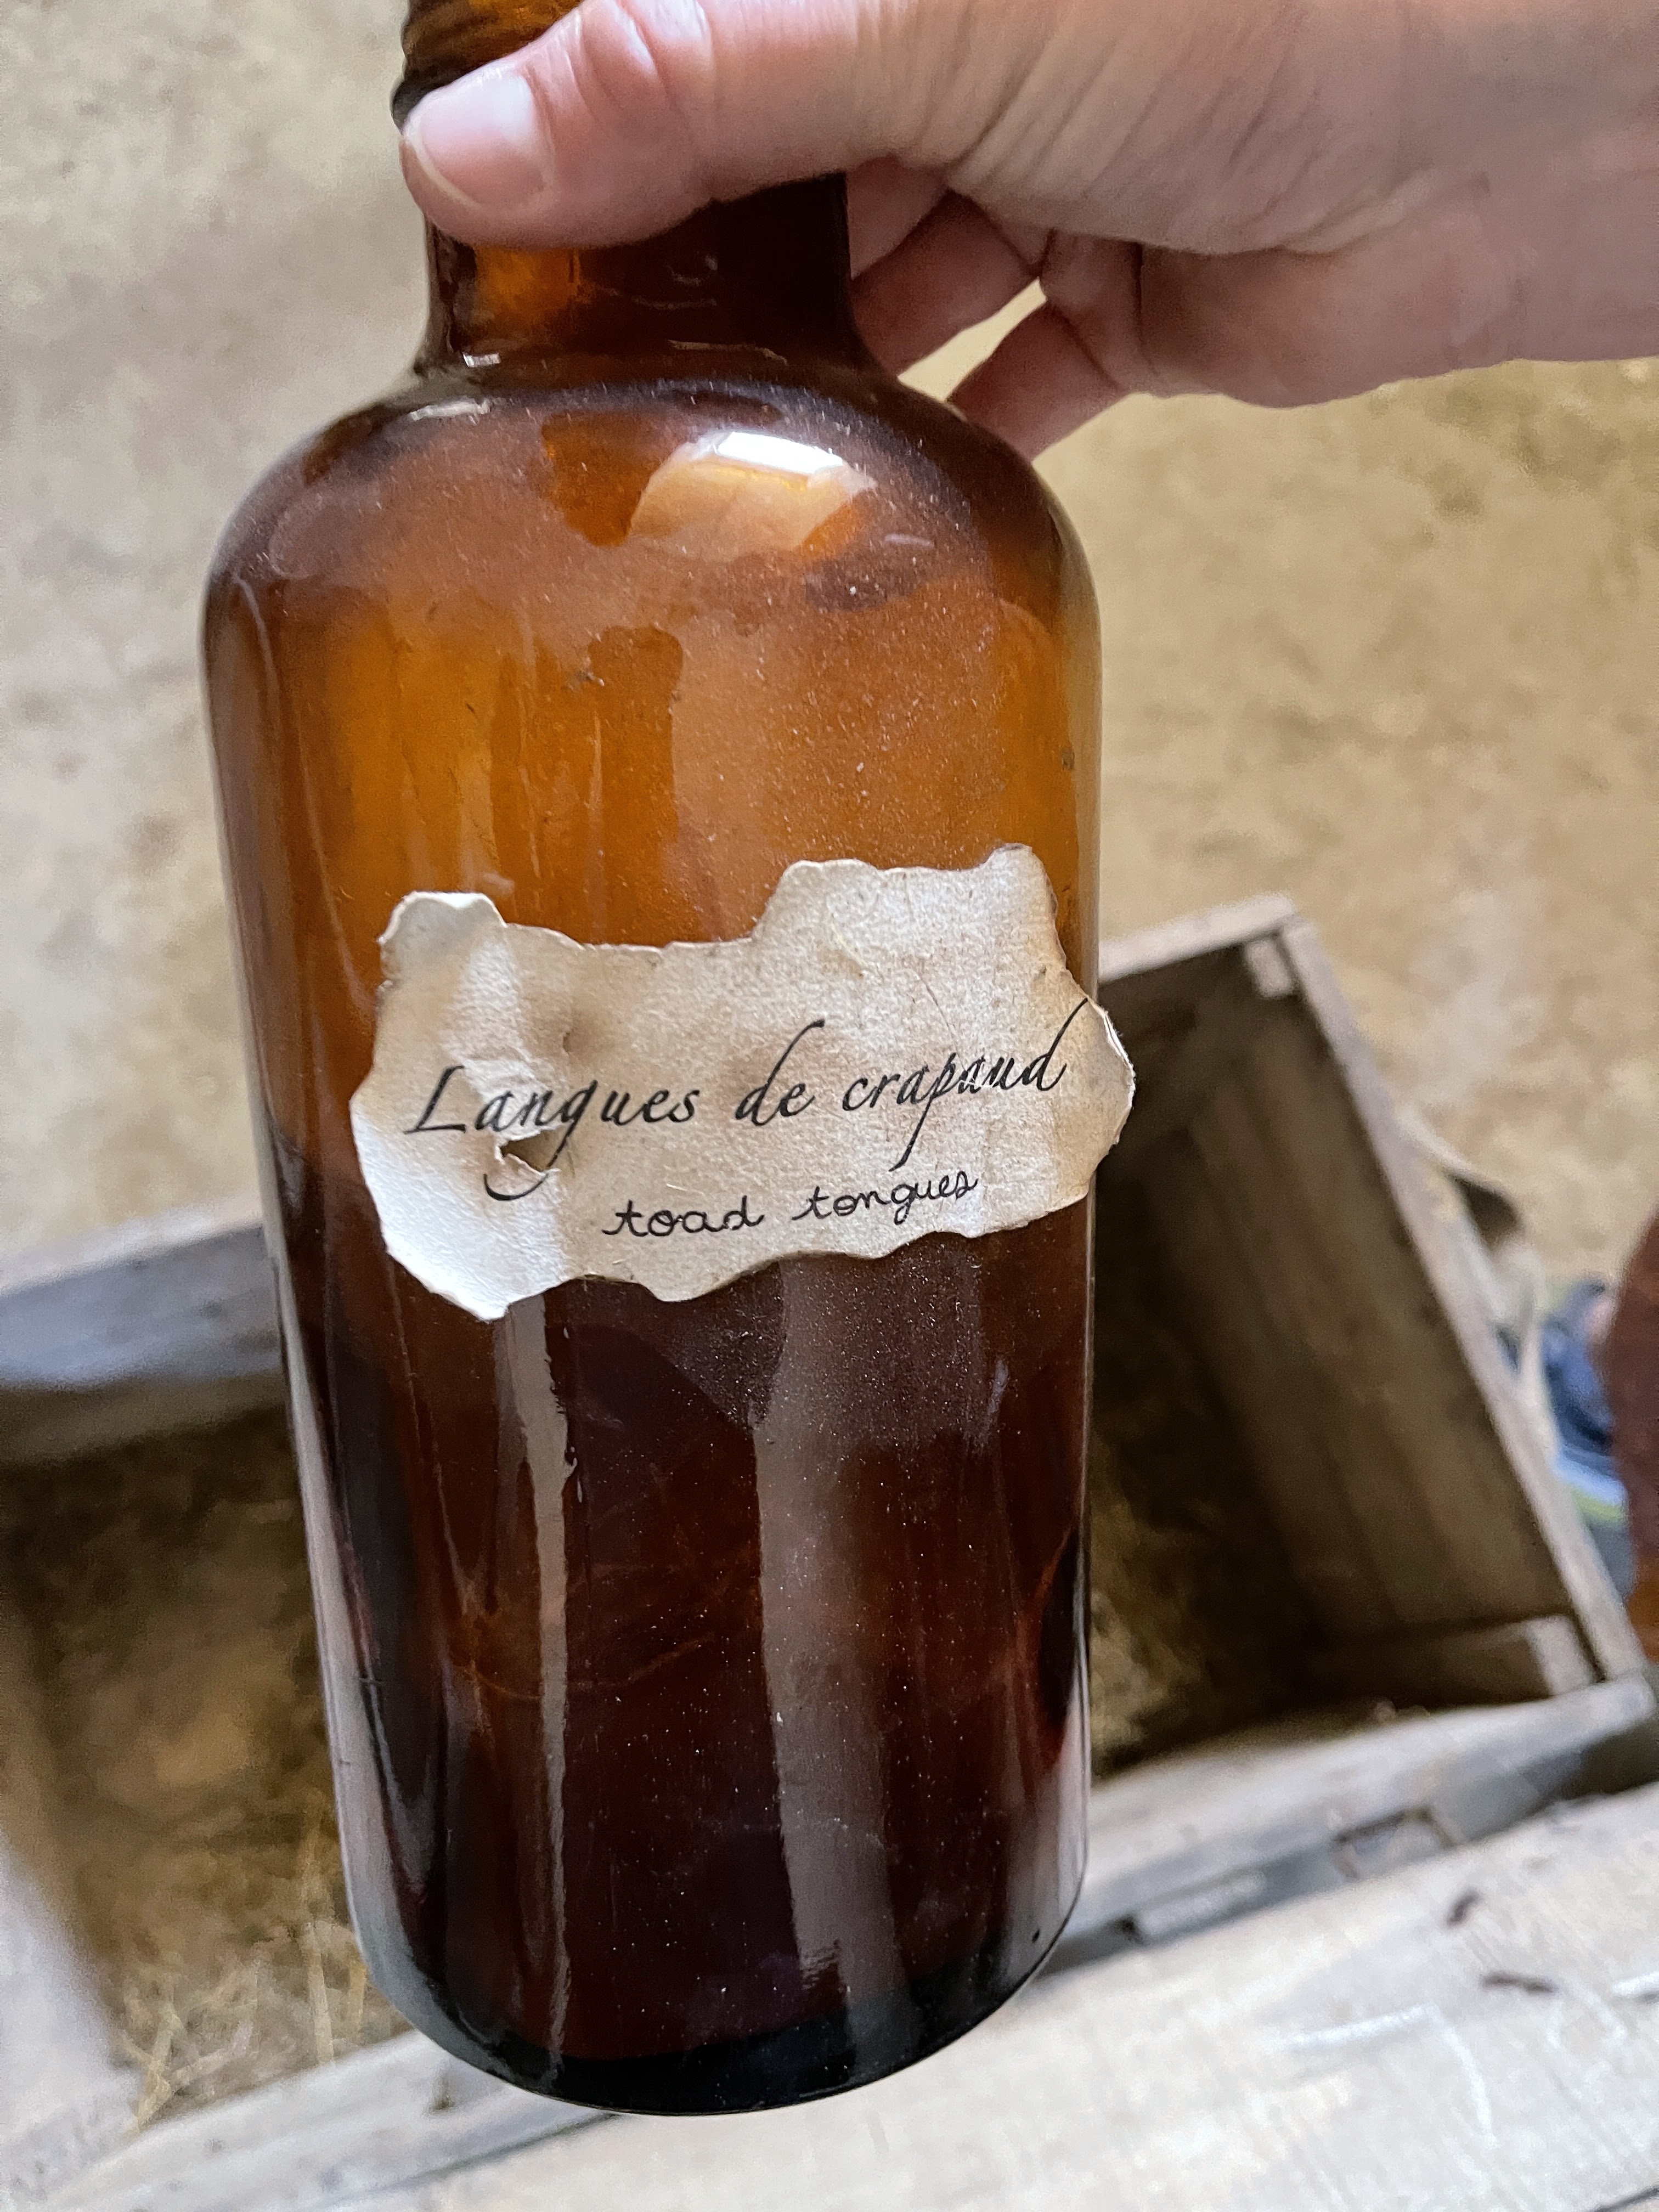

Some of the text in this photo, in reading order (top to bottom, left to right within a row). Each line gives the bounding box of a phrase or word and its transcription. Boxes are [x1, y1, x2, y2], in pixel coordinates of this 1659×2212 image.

[404, 998, 1088, 1201] Langues de crapaud
[602, 1169, 979, 1238] toad tongues
